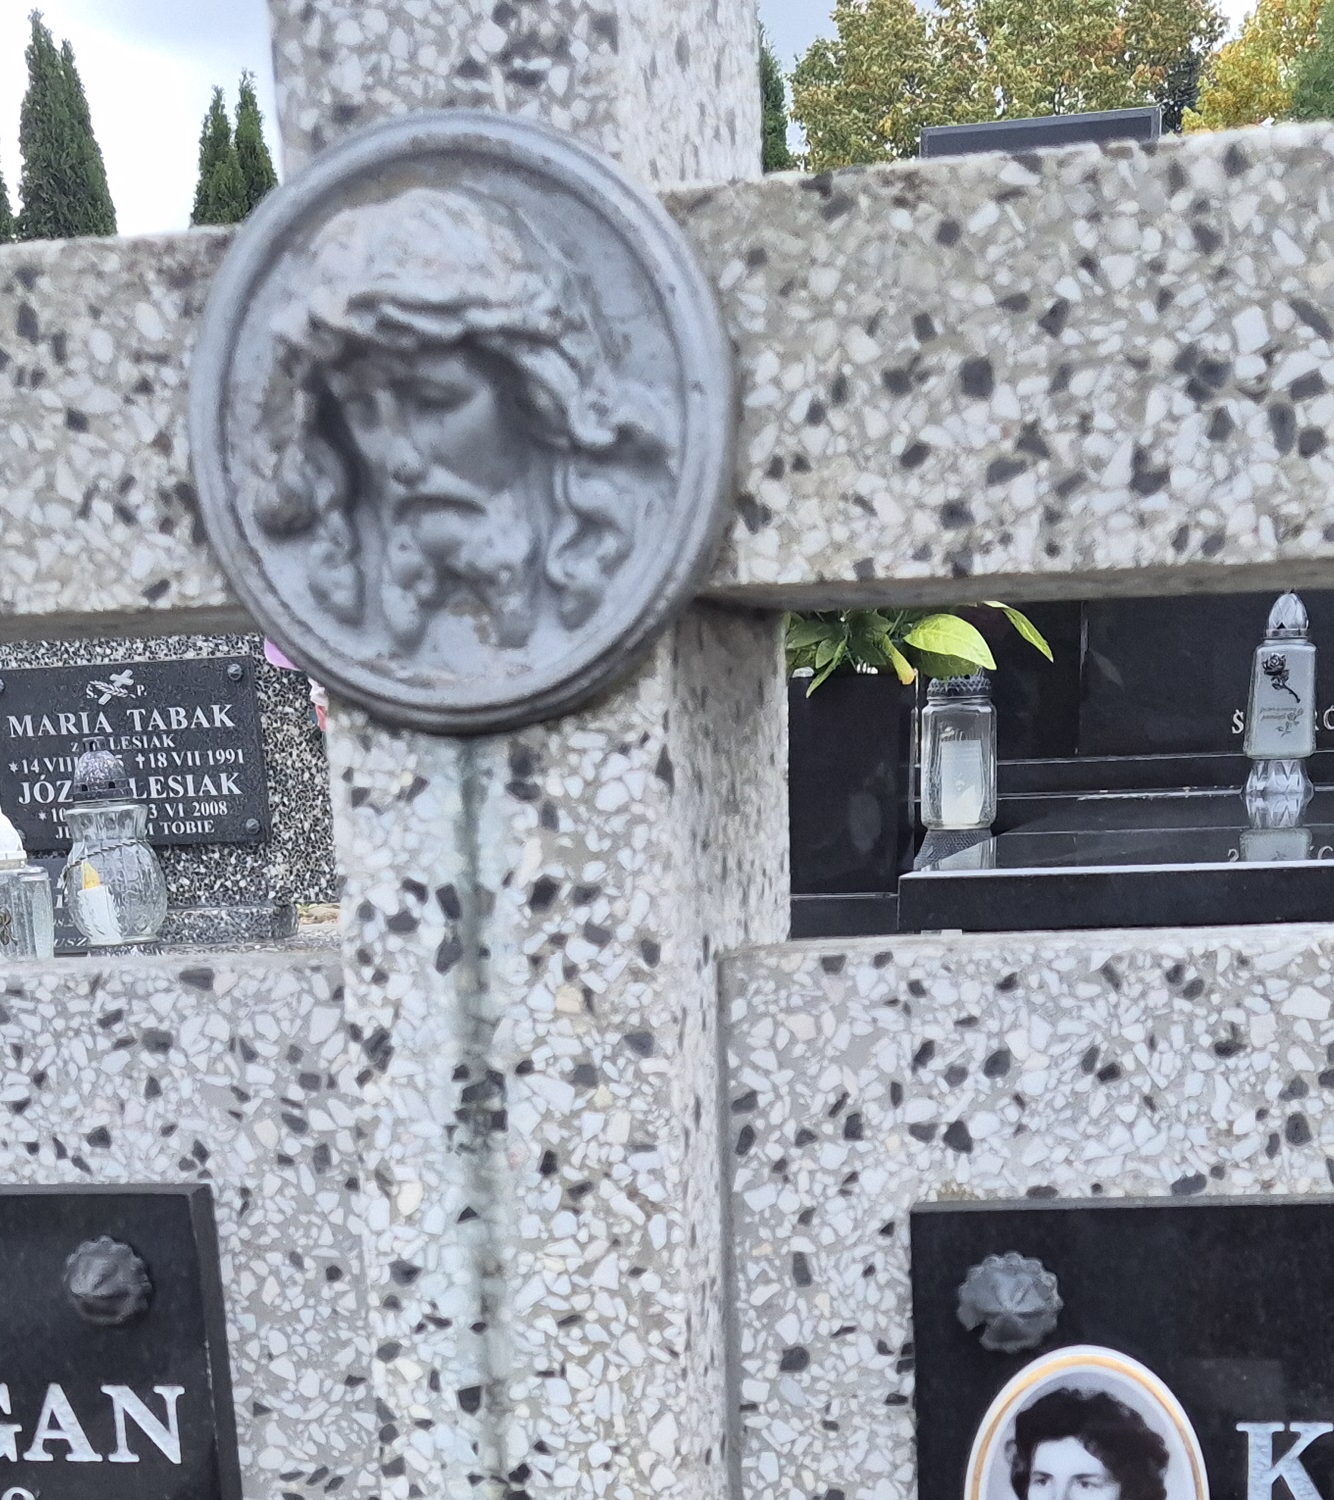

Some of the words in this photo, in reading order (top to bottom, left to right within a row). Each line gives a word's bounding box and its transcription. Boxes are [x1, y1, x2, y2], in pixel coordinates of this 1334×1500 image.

[6, 711, 114, 738] MARIA
[126, 704, 236, 732] TABAK
[109, 734, 176, 750] LESIAK
[148, 752, 168, 768] 18
[170, 750, 202, 767] VII
[207, 748, 245, 765] 1991
[17, 774, 74, 805] JÓZ
[128, 771, 244, 800] LESIAK
[192, 800, 229, 817] 2008
[159, 819, 216, 836] TOBIE
